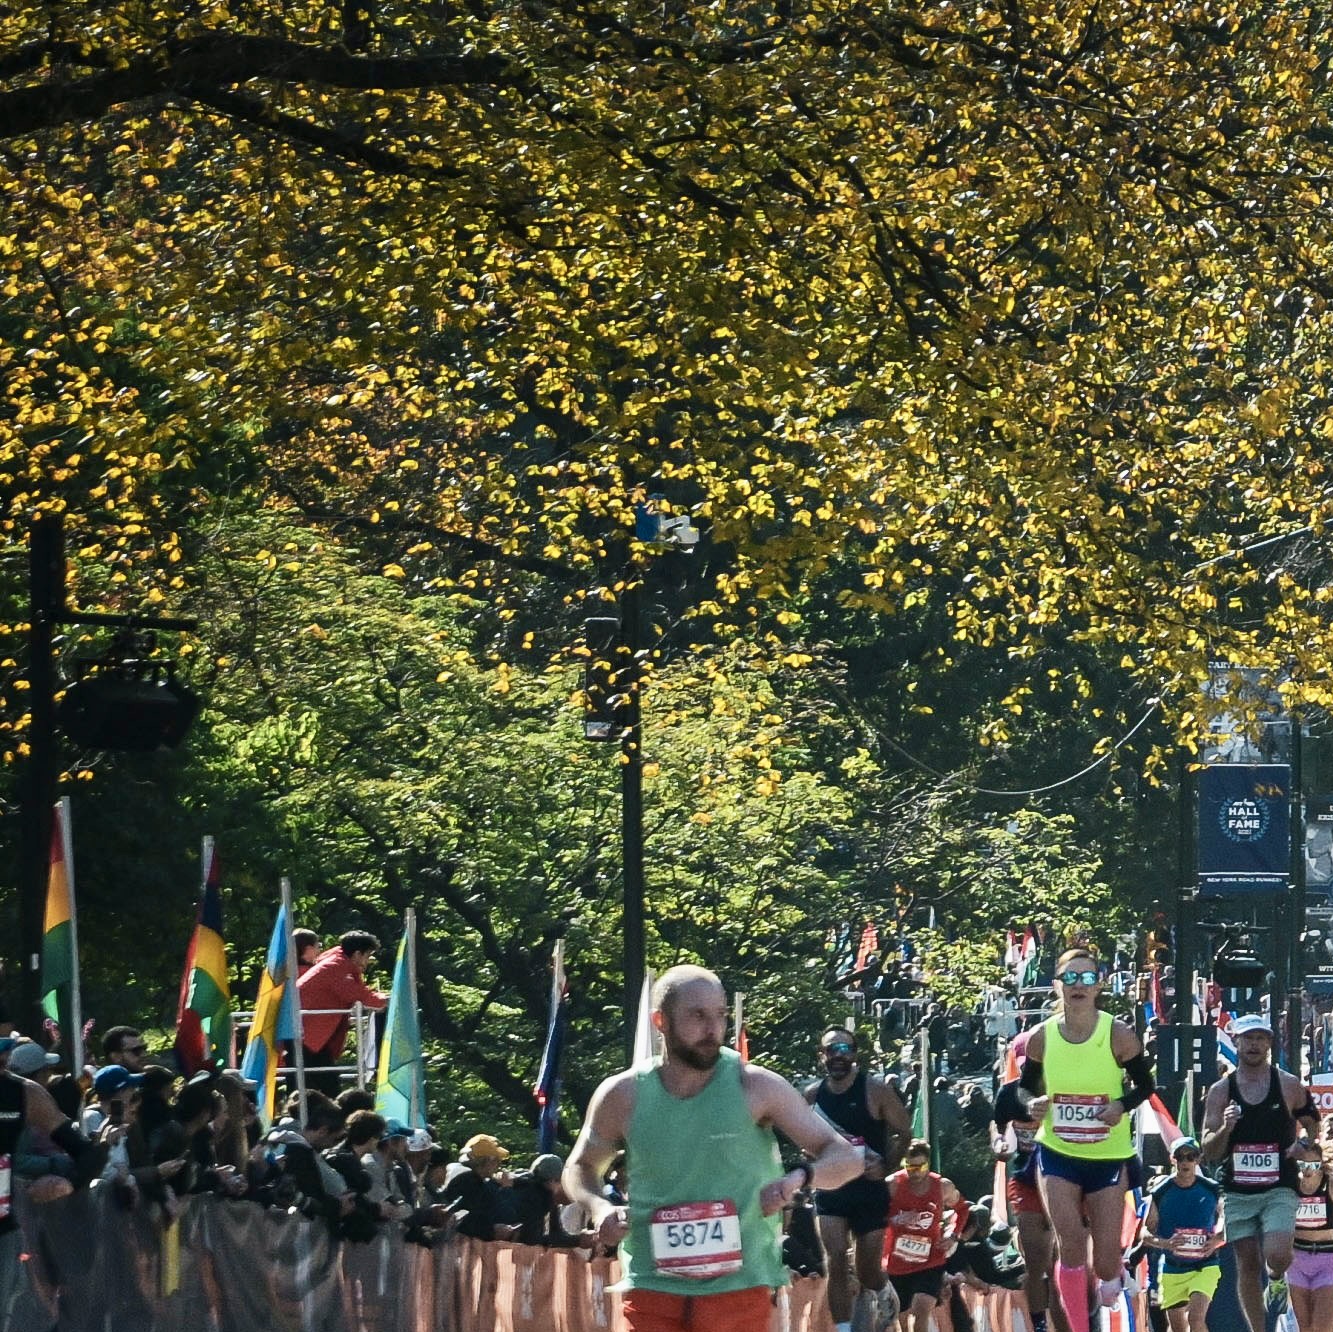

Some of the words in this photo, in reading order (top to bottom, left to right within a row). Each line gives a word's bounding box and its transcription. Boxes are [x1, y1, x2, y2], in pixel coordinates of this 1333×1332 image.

[1228, 807, 1260, 816] HALL
[1228, 820, 1260, 828] FAME
[1241, 1154, 1272, 1167] 4106
[667, 1220, 724, 1248] 5874
